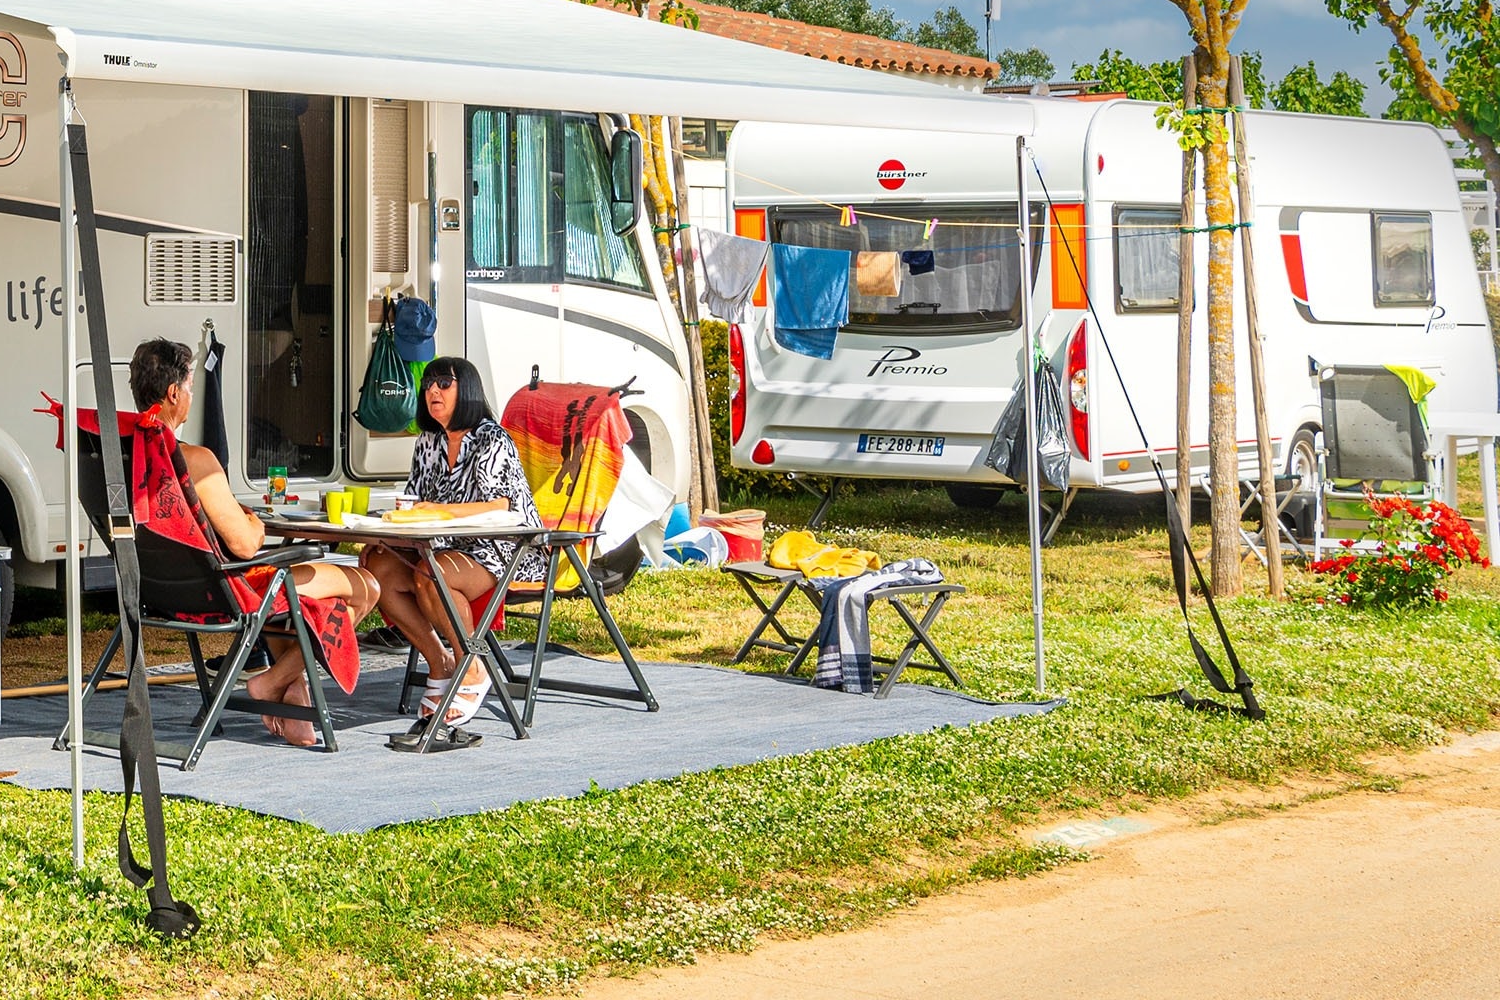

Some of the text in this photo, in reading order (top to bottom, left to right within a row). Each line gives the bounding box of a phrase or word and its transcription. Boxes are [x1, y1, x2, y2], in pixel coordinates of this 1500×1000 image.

[103, 54, 131, 66] THULE
[466, 269, 504, 280] carthago
[867, 345, 948, 377] Premio
